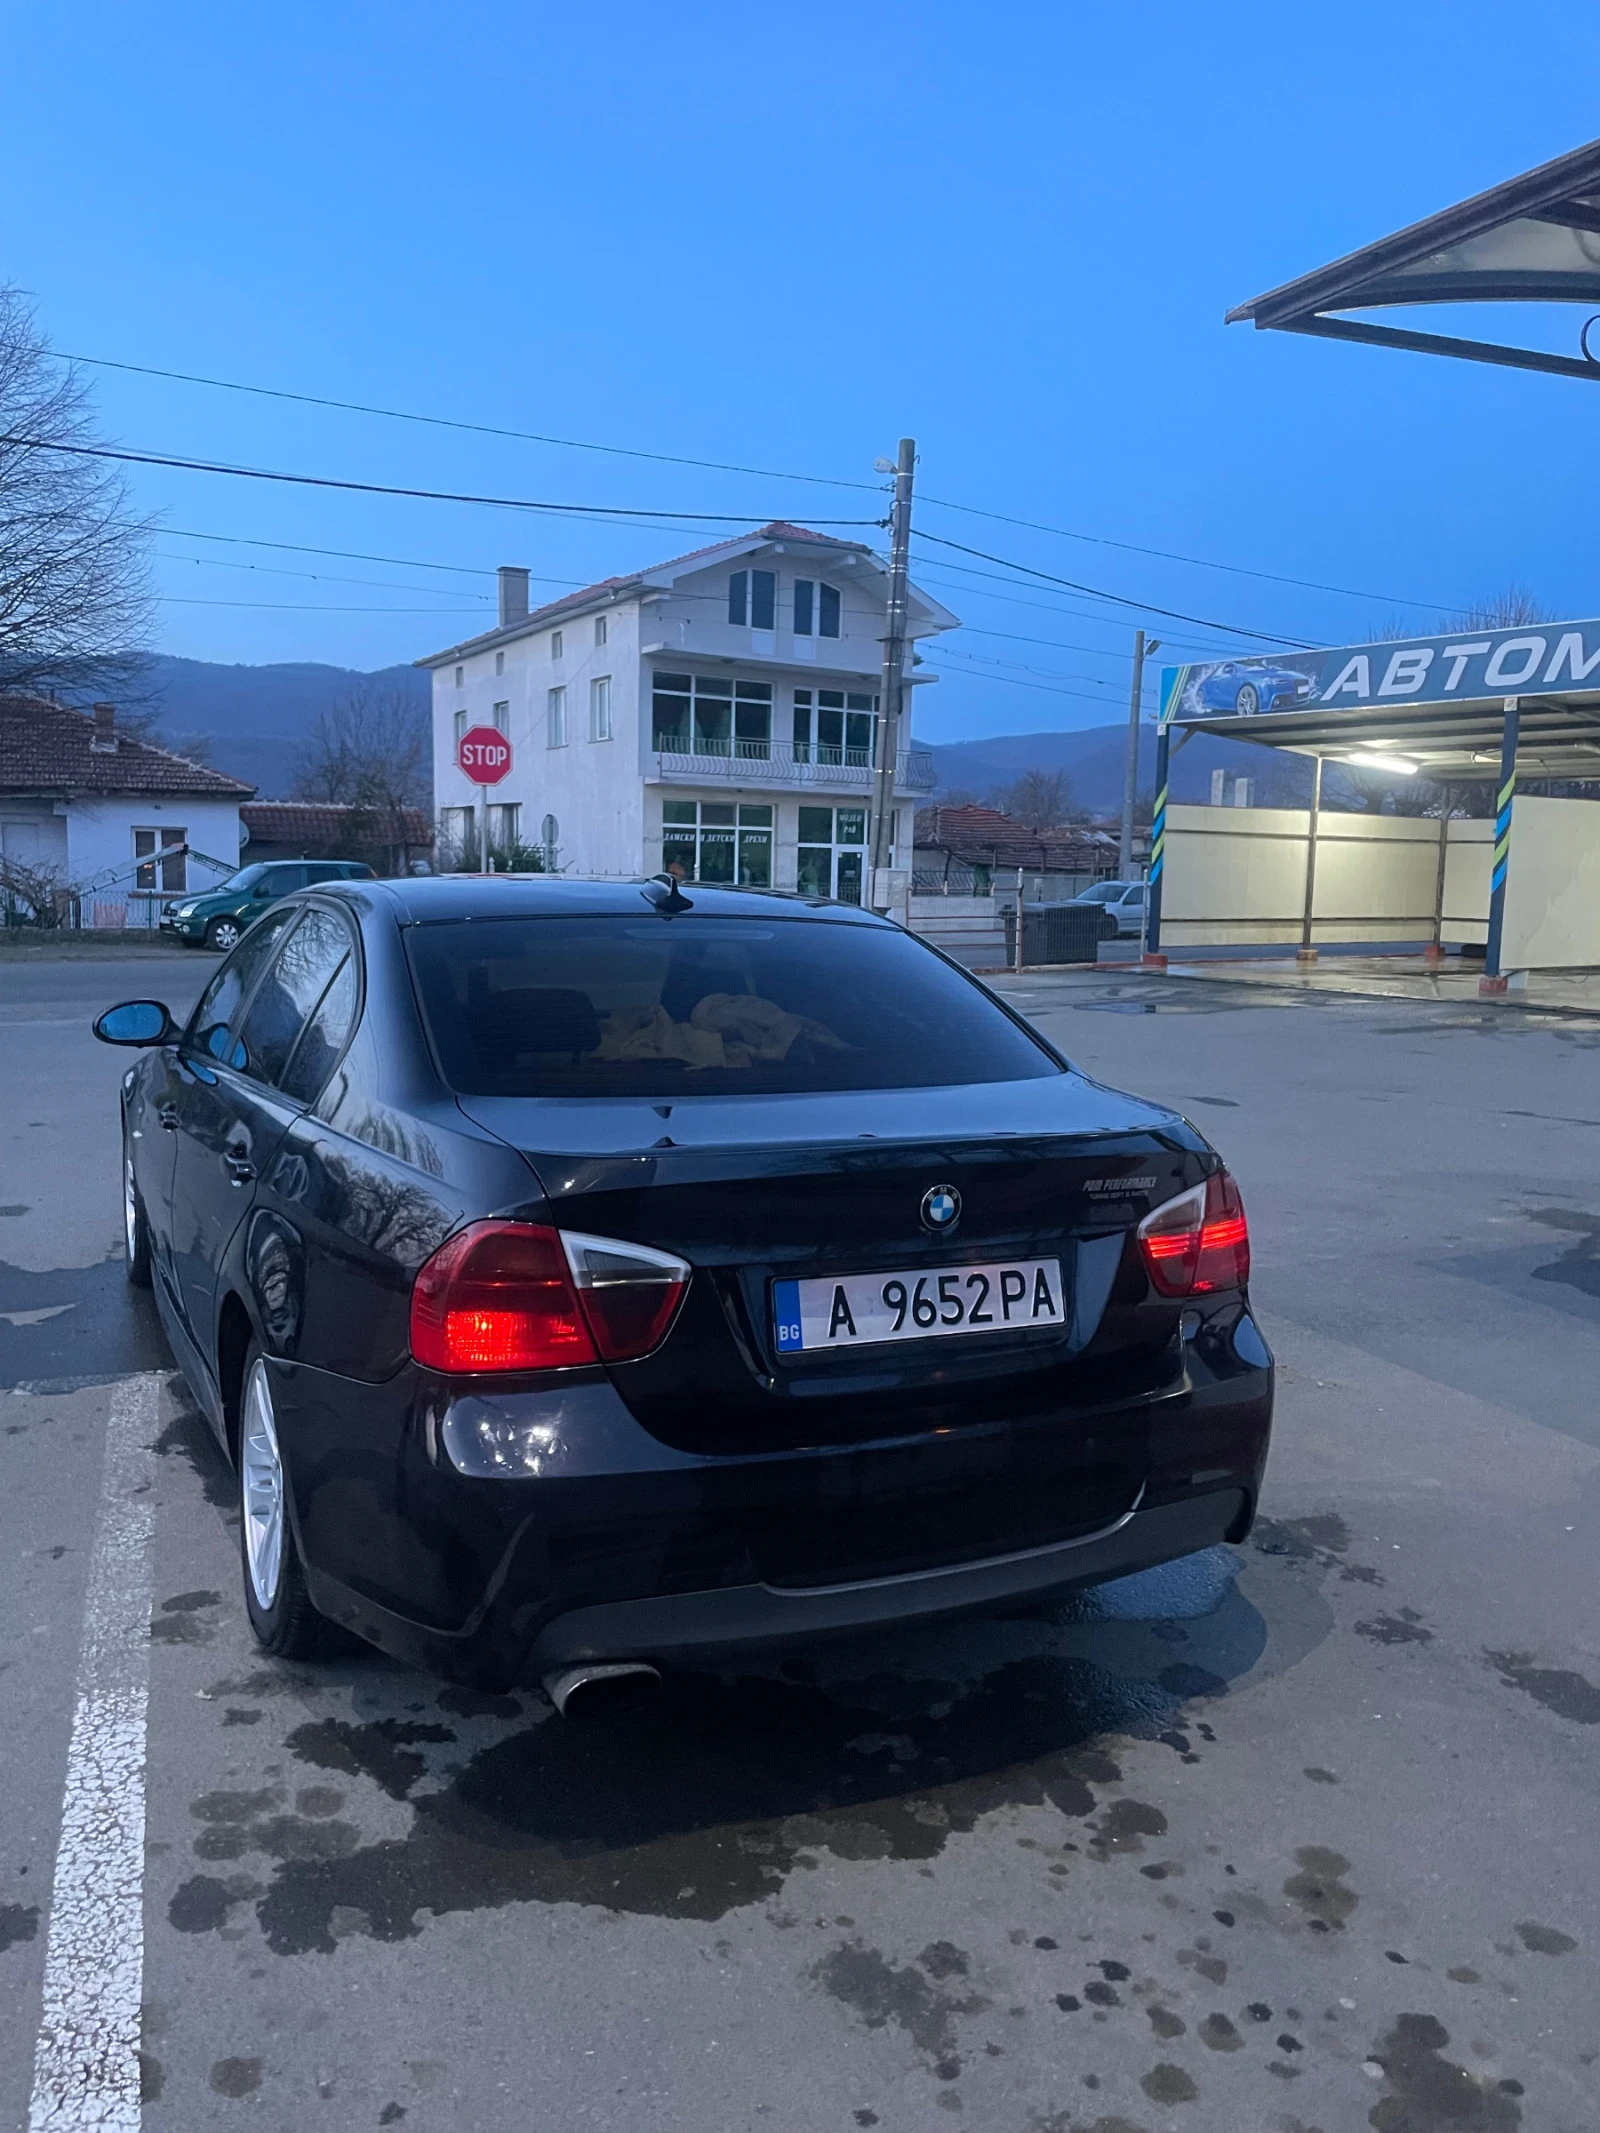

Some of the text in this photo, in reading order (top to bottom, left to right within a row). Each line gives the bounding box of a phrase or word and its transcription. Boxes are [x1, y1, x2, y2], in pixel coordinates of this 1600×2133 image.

[1506, 699, 1515, 708] 2
[462, 744, 508, 766] STOP
[664, 832, 696, 842] ДАМСКИ
[705, 833, 737, 843] ДЕТСКИ
[742, 834, 768, 844] ДРЕХИ
[1103, 1176, 1157, 1191] PERFORMANCE
[828, 1285, 857, 1338] A
[779, 1325, 800, 1341] BG
